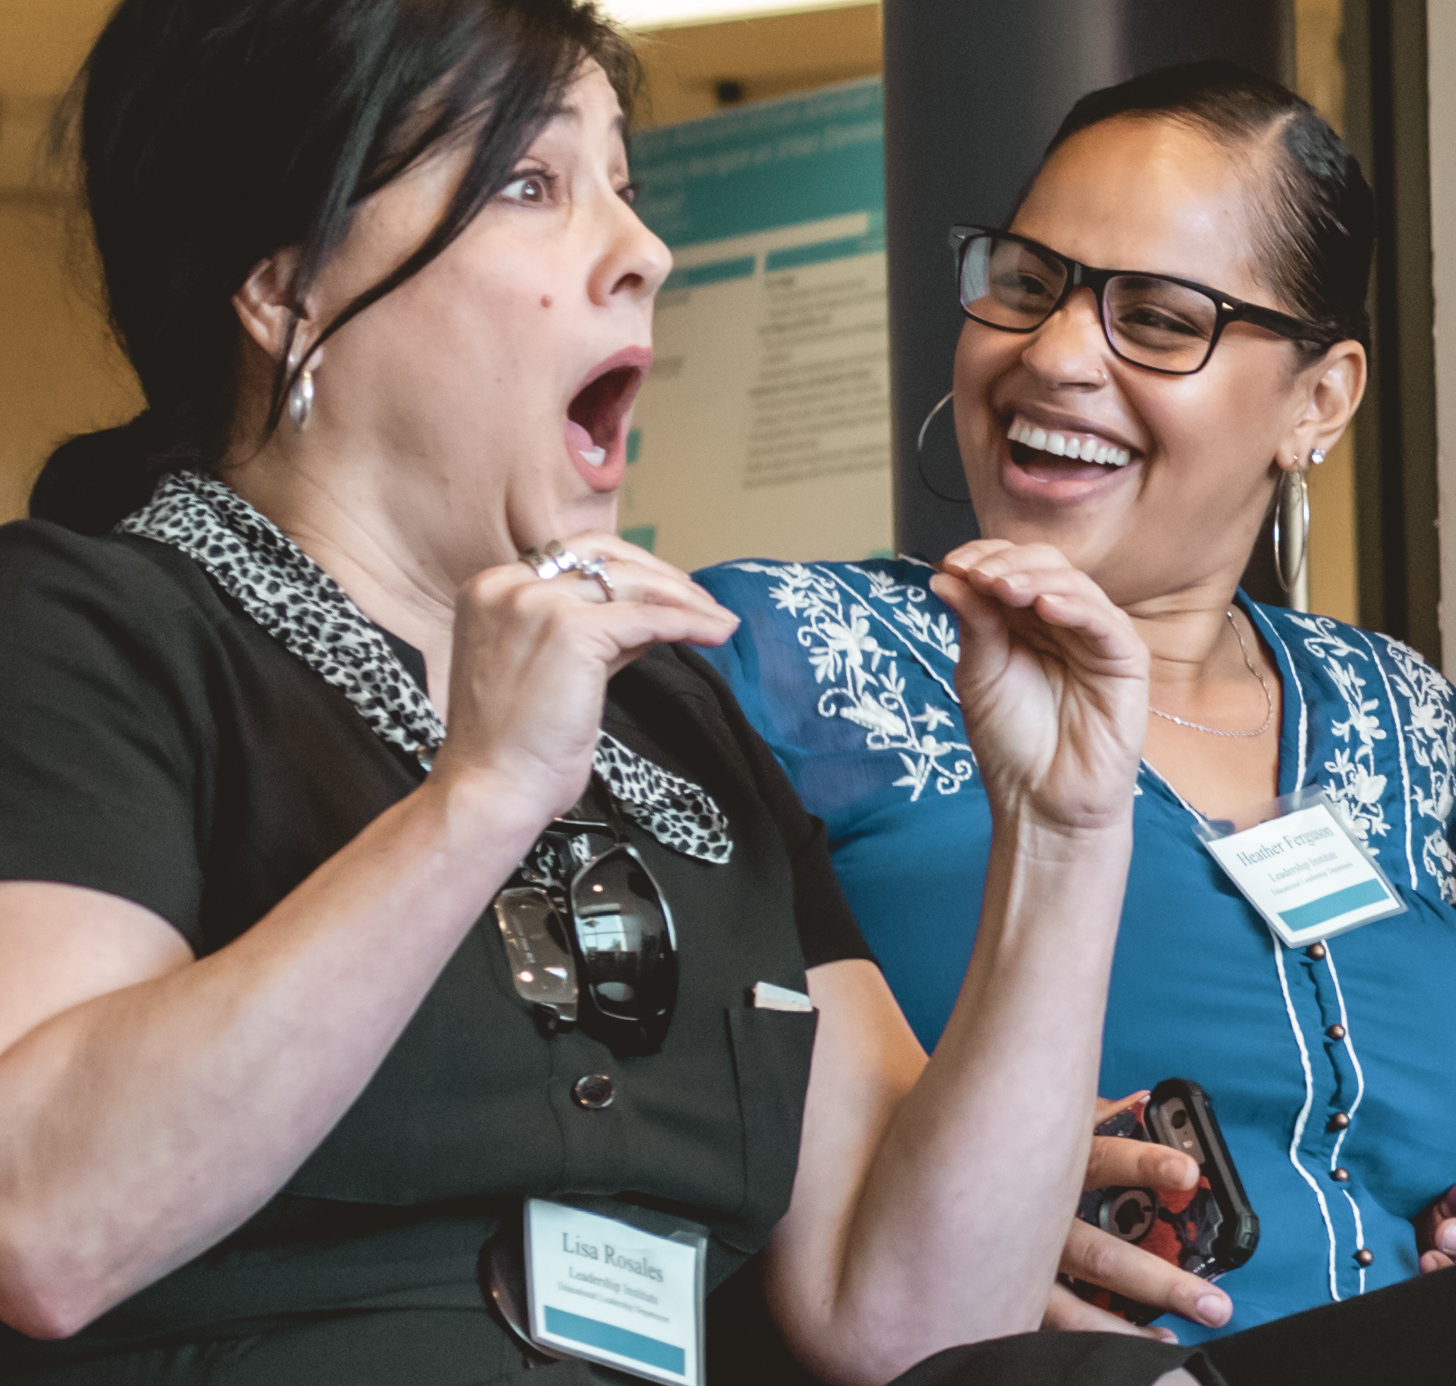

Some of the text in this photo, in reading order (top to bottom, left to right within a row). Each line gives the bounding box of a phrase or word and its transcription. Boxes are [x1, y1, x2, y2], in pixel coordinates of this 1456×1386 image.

[1236, 827, 1335, 866] Heather Ferguson
[561, 1232, 664, 1283] Lisa Rosales
